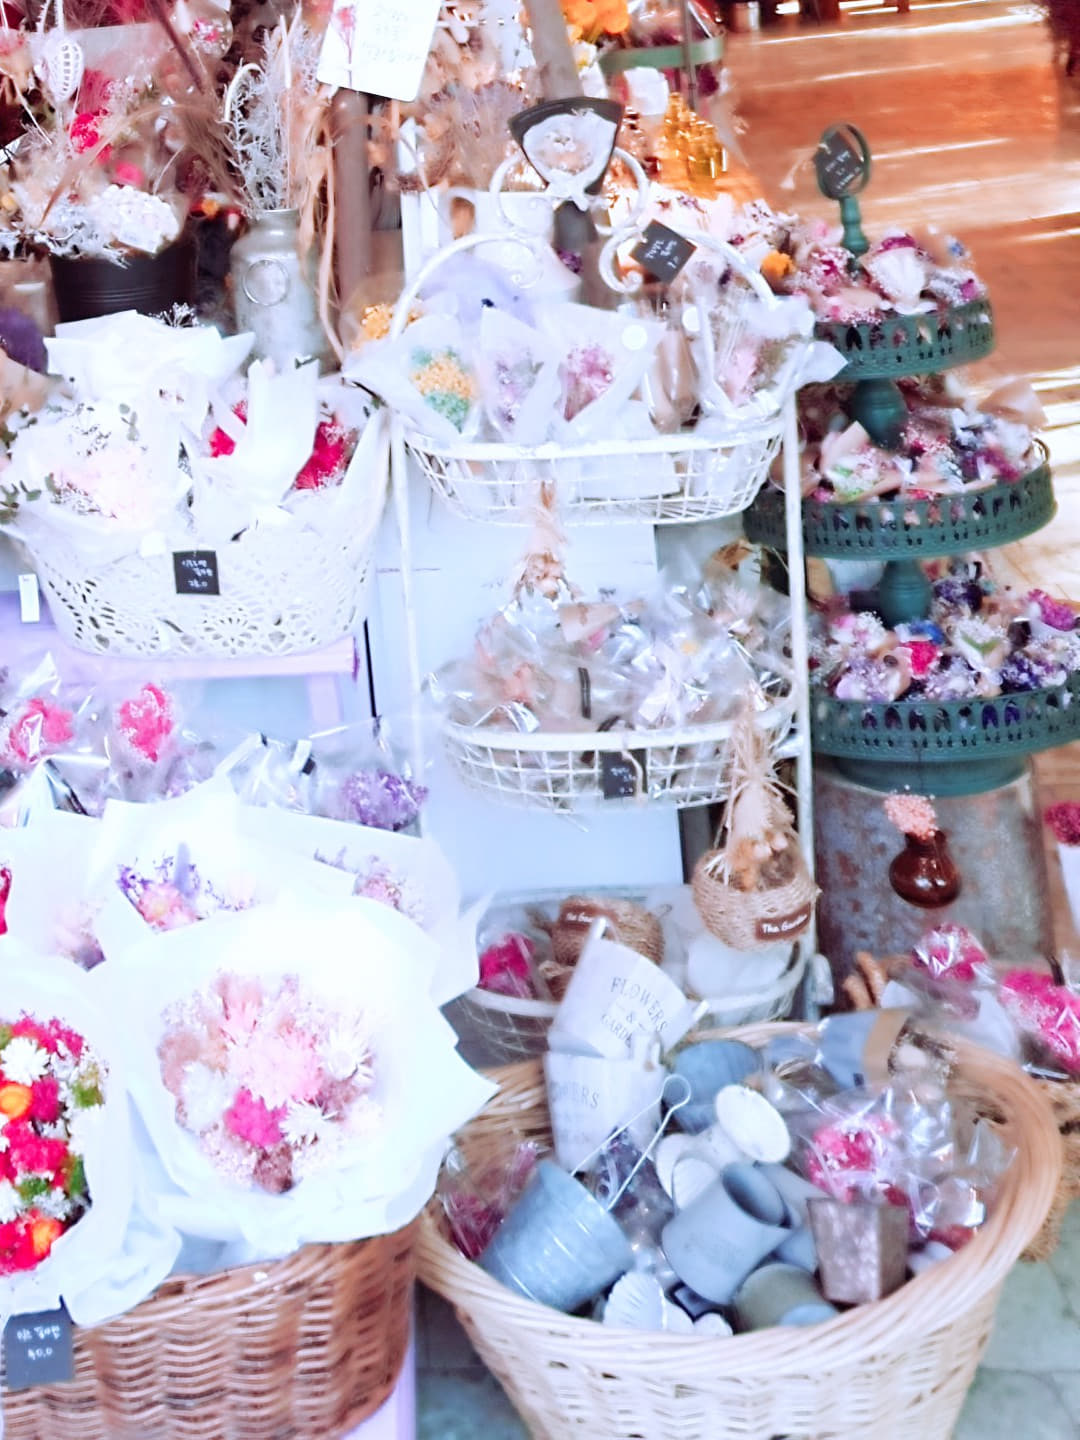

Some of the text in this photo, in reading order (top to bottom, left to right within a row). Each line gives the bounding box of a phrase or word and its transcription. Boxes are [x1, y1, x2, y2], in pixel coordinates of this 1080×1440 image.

[762, 923, 780, 934] The
[610, 976, 668, 1033] FLOWERS
[600, 1012, 633, 1049] GARDE
